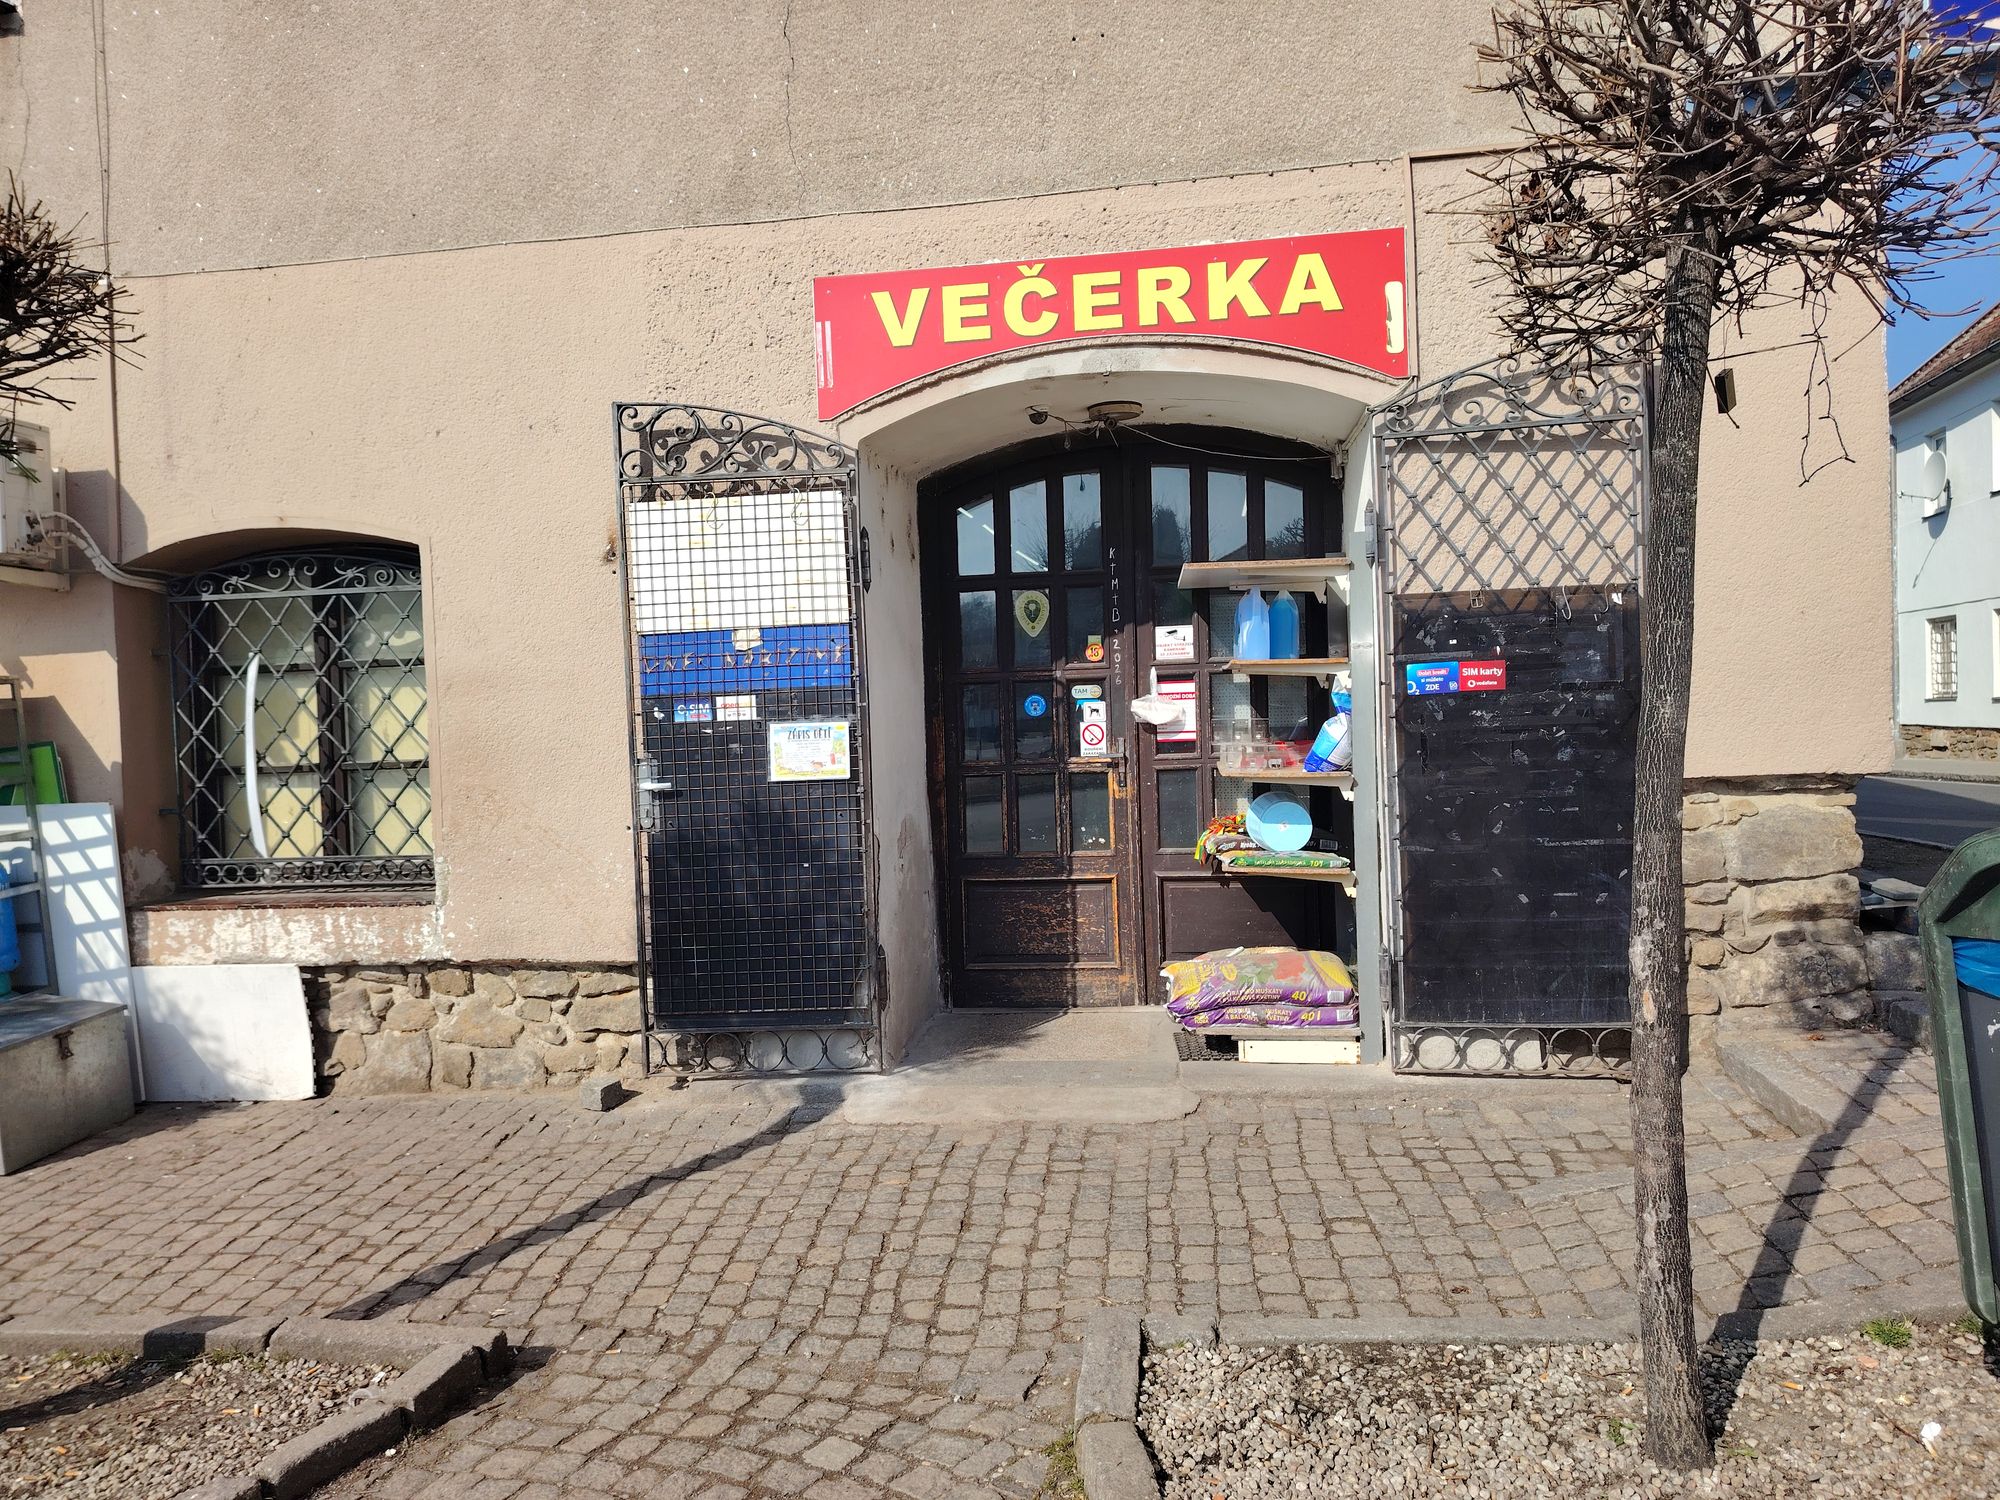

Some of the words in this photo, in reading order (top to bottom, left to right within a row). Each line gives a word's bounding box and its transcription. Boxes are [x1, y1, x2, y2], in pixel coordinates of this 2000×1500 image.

[871, 252, 1344, 348] VEČERKA
[1462, 667, 1479, 676] SIM
[1479, 667, 1503, 677] karty
[1425, 683, 1440, 691] ZDE
[689, 703, 710, 714] SIM
[787, 728, 811, 740] ZÁPIS
[1291, 990, 1307, 1001] 40
[1300, 1011, 1315, 1021] 40
